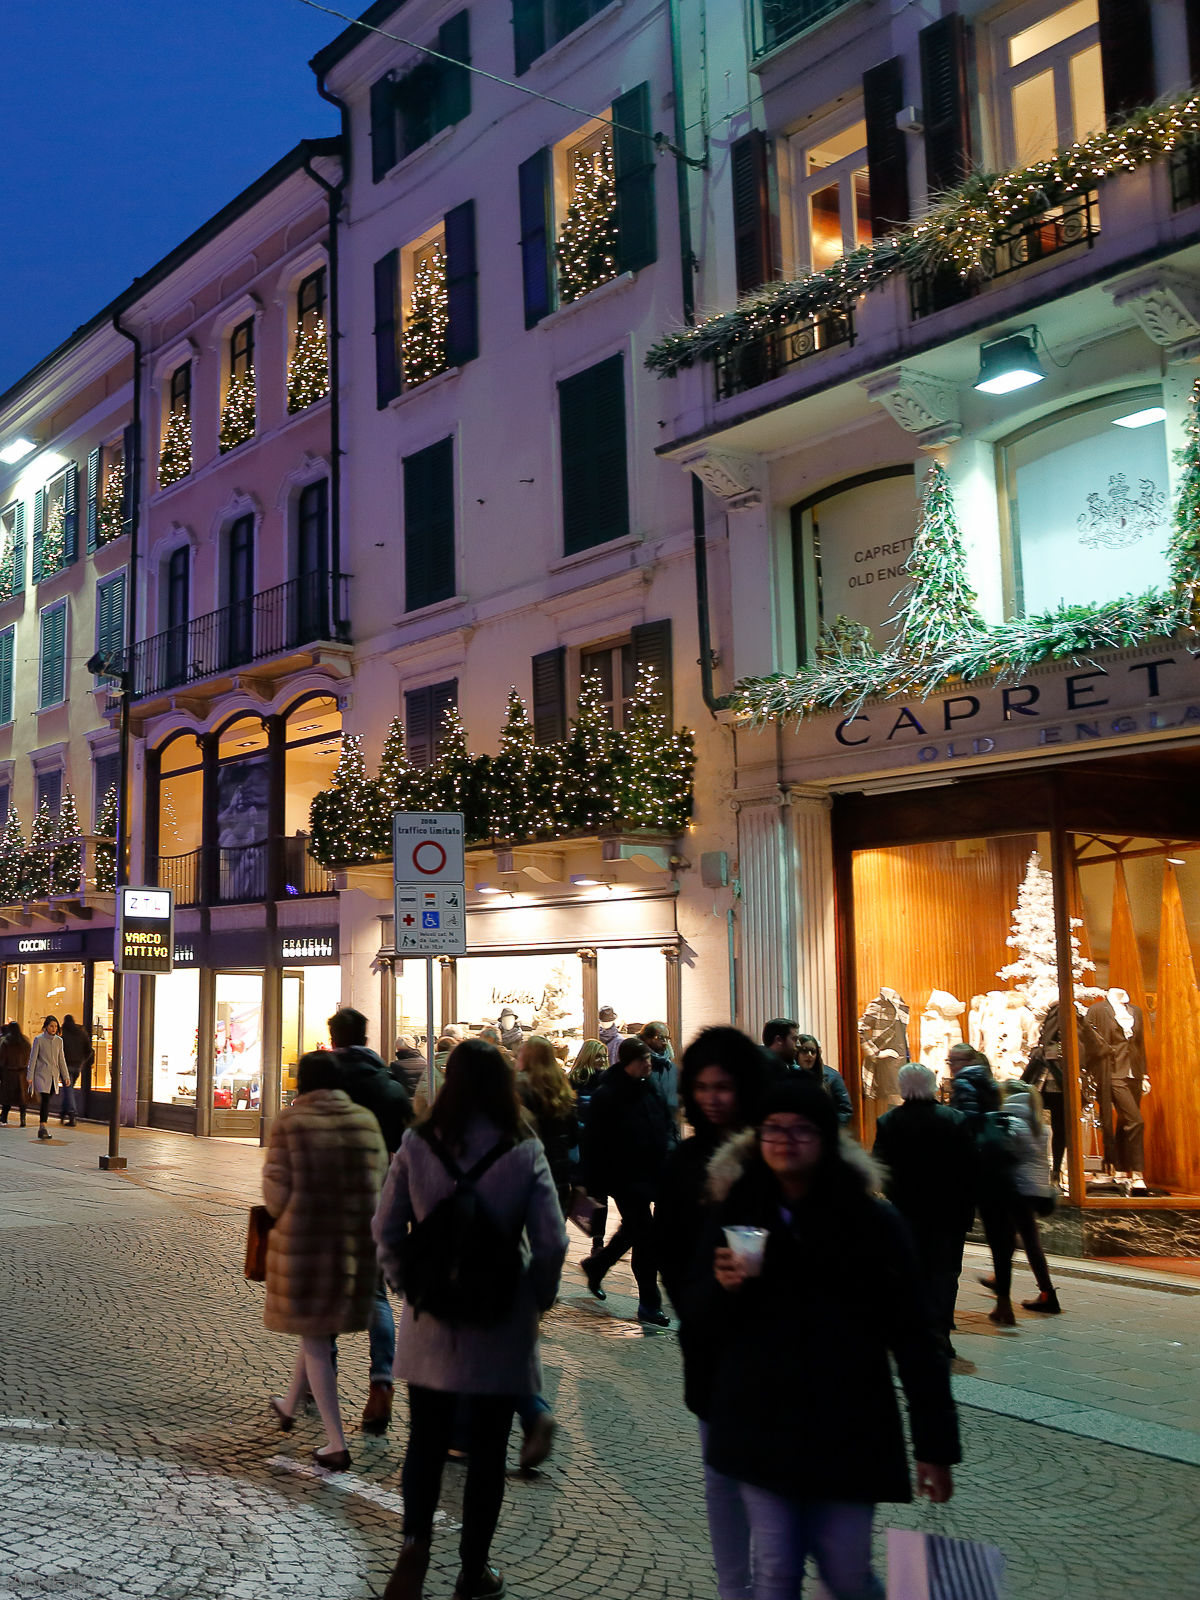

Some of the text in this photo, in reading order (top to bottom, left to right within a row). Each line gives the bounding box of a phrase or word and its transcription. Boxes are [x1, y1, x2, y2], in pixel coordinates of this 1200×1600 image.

[848, 572, 875, 588] OLD
[835, 655, 1200, 746] CAPRET
[918, 737, 995, 762] OLD
[398, 826, 460, 835] traffico limitato
[125, 932, 161, 944] VARCO
[283, 938, 332, 948] FRATELLI
[19, 938, 62, 953] COCCINELLE
[124, 945, 168, 958] ATTIVO
